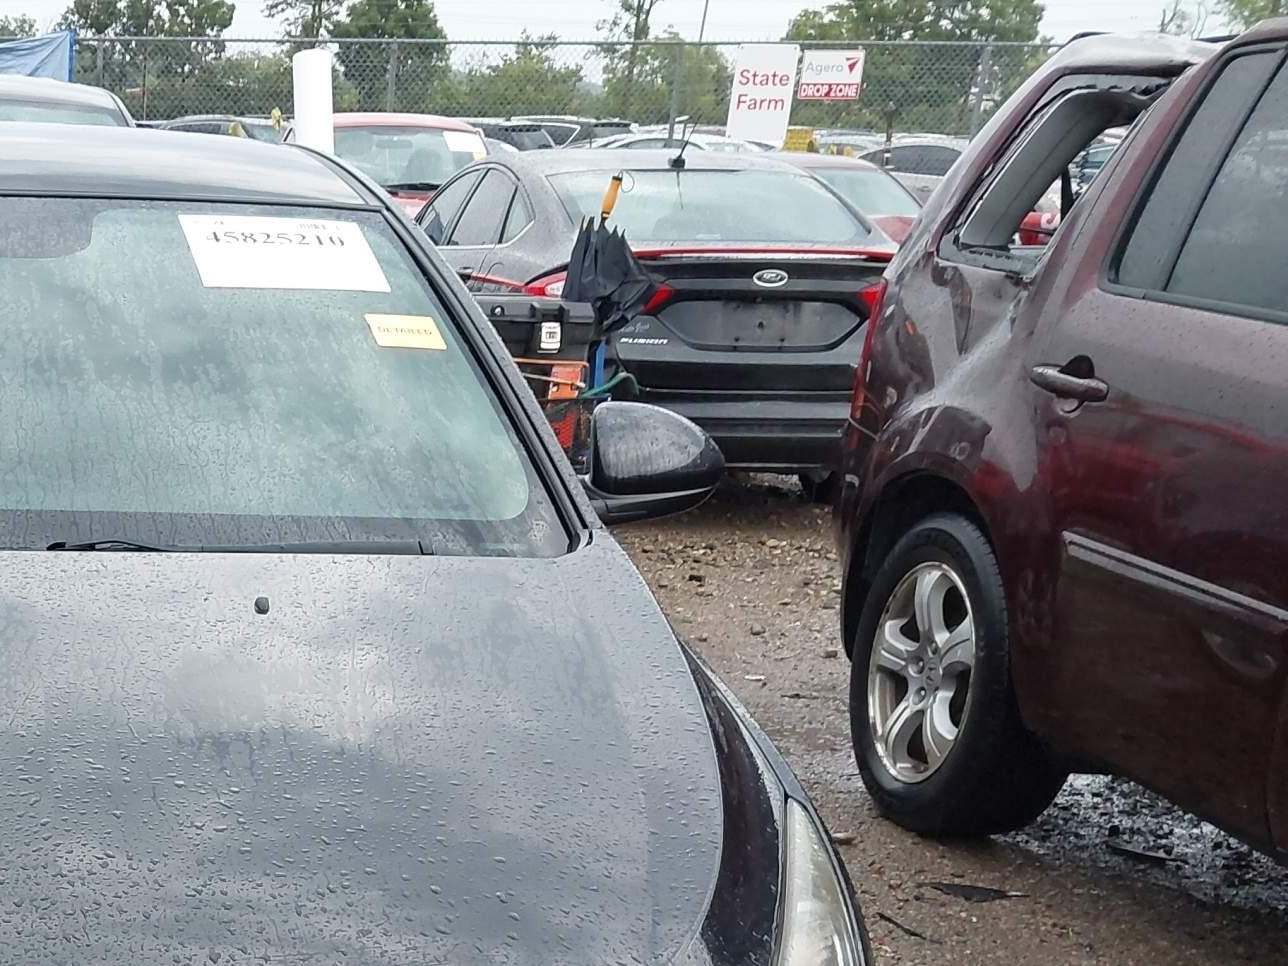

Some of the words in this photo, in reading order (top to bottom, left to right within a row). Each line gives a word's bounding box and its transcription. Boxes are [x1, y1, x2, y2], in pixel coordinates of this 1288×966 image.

[804, 61, 844, 76] Agero
[738, 69, 790, 87] State
[800, 83, 829, 97] DROP
[829, 83, 858, 97] ZONE
[736, 93, 785, 111] Farm
[206, 231, 346, 248] 45825210
